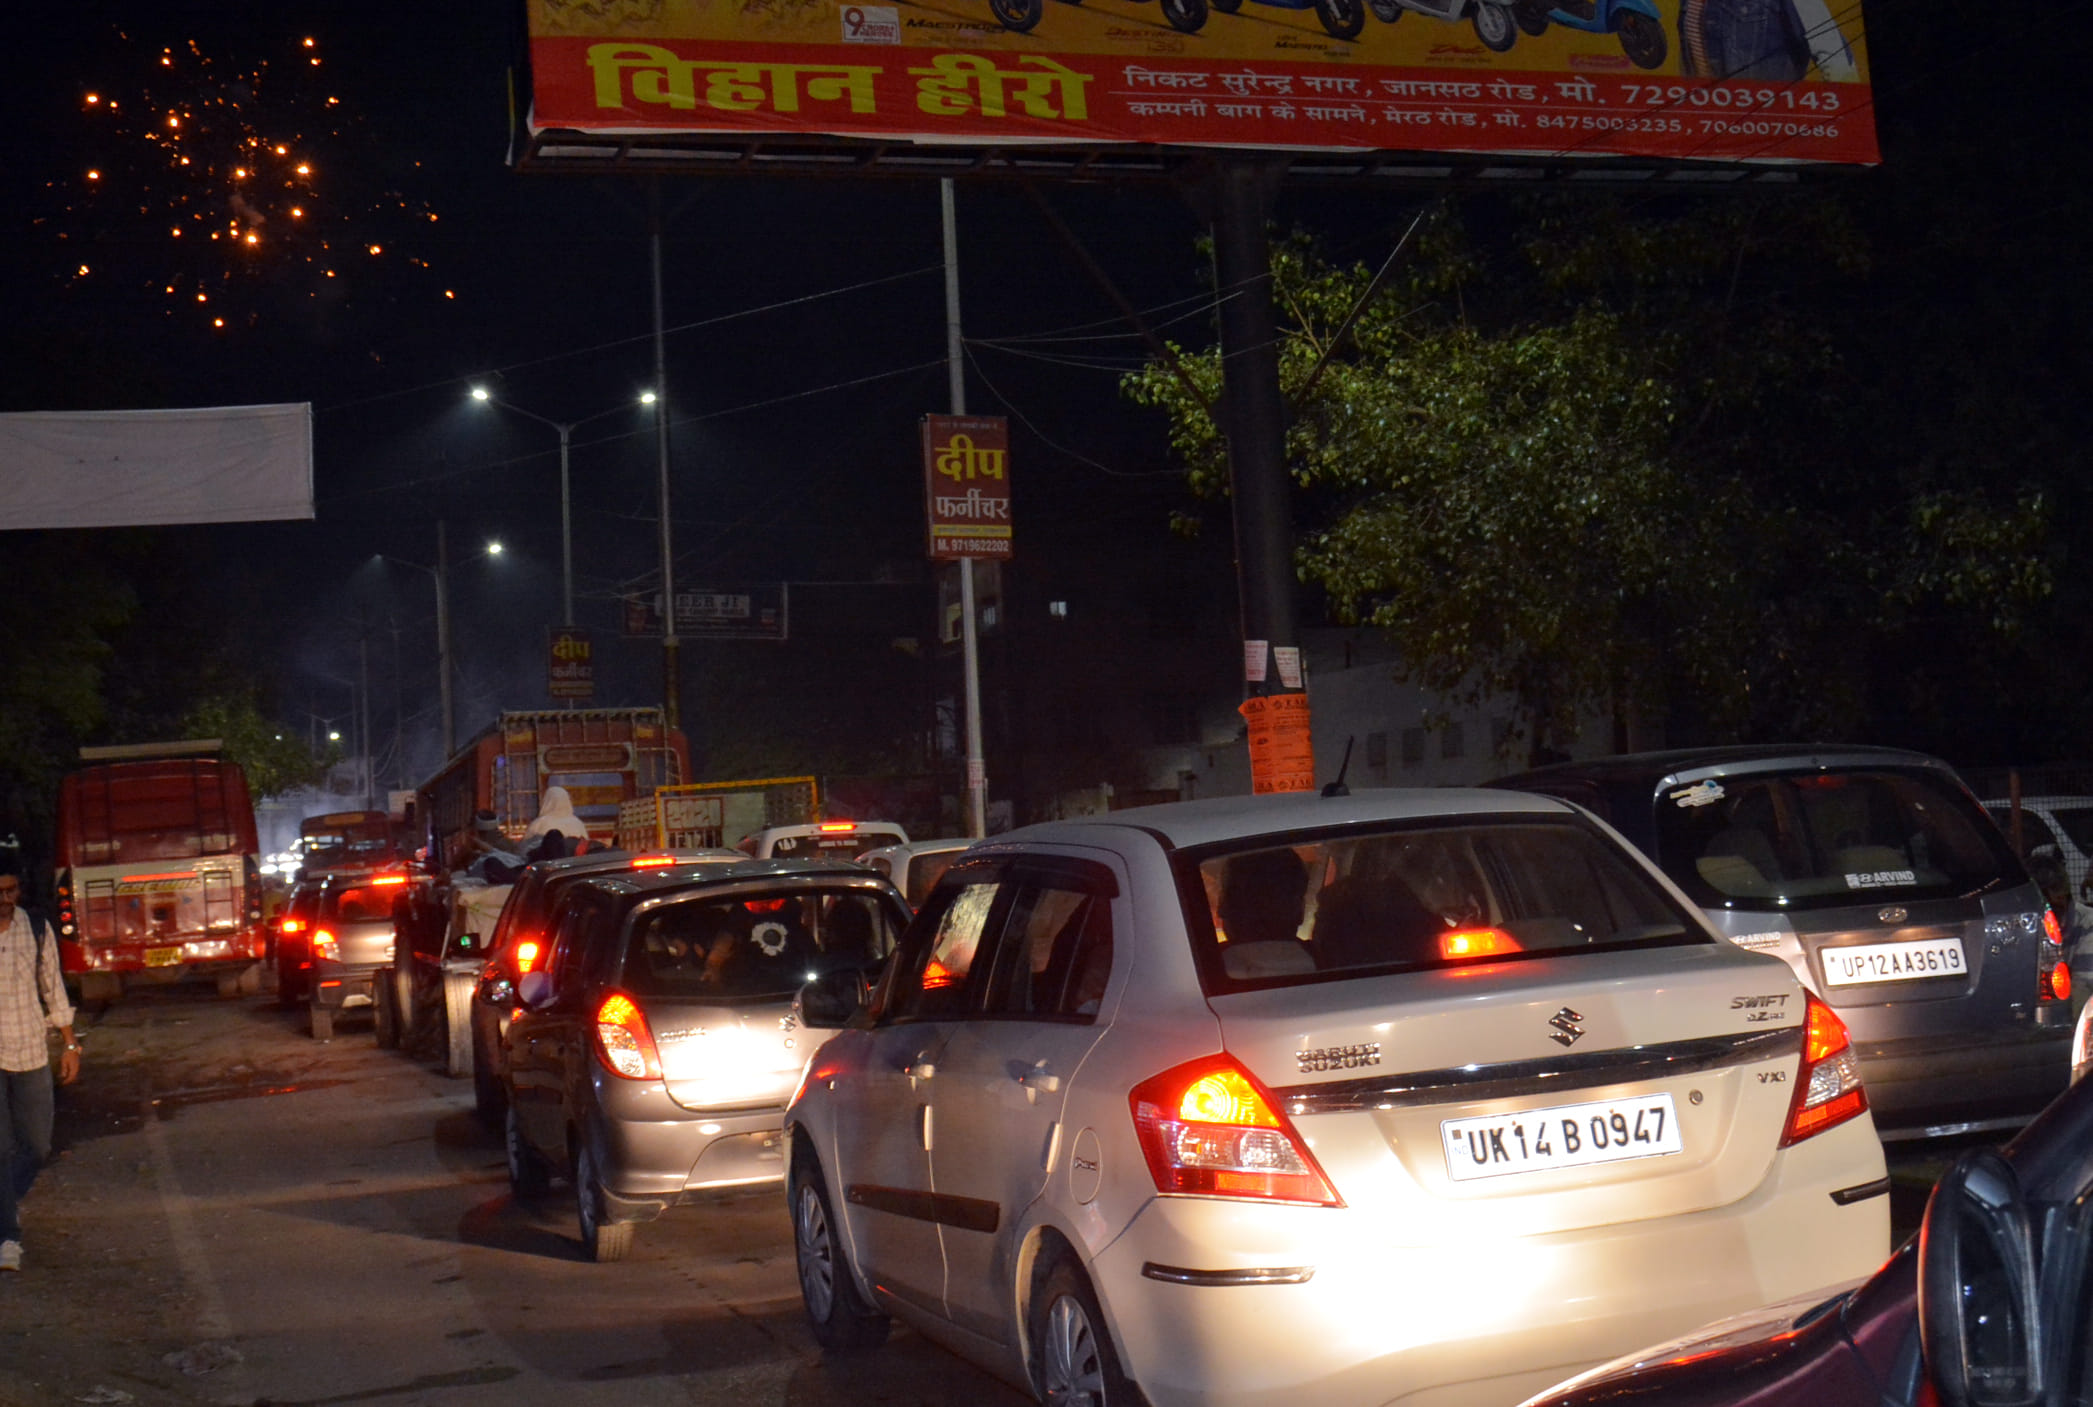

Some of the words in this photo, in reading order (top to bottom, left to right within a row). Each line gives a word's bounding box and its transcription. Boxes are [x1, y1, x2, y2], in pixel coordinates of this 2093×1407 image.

[586, 43, 884, 114] विहान
[907, 53, 1093, 121] हीरो
[1122, 65, 1210, 88] निकट
[1217, 69, 1293, 96] सुरेन्द्र
[1379, 79, 1482, 98] जानसठ
[1555, 75, 1606, 104] मो.
[1620, 84, 1841, 111] 7290039143
[1127, 98, 1208, 118] कम्पनी
[1214, 104, 1263, 119] बाग
[1268, 101, 1296, 120] के
[1382, 105, 1433, 124] मेरठ
[1493, 109, 1528, 128] मो.
[934, 434, 1007, 482] दीप
[935, 488, 1009, 519] फर्नीचर
[1873, 870, 1915, 882] ARVIND
[1730, 994, 1790, 1009] SWIFT
[1298, 1053, 1382, 1074] SUZUKI
